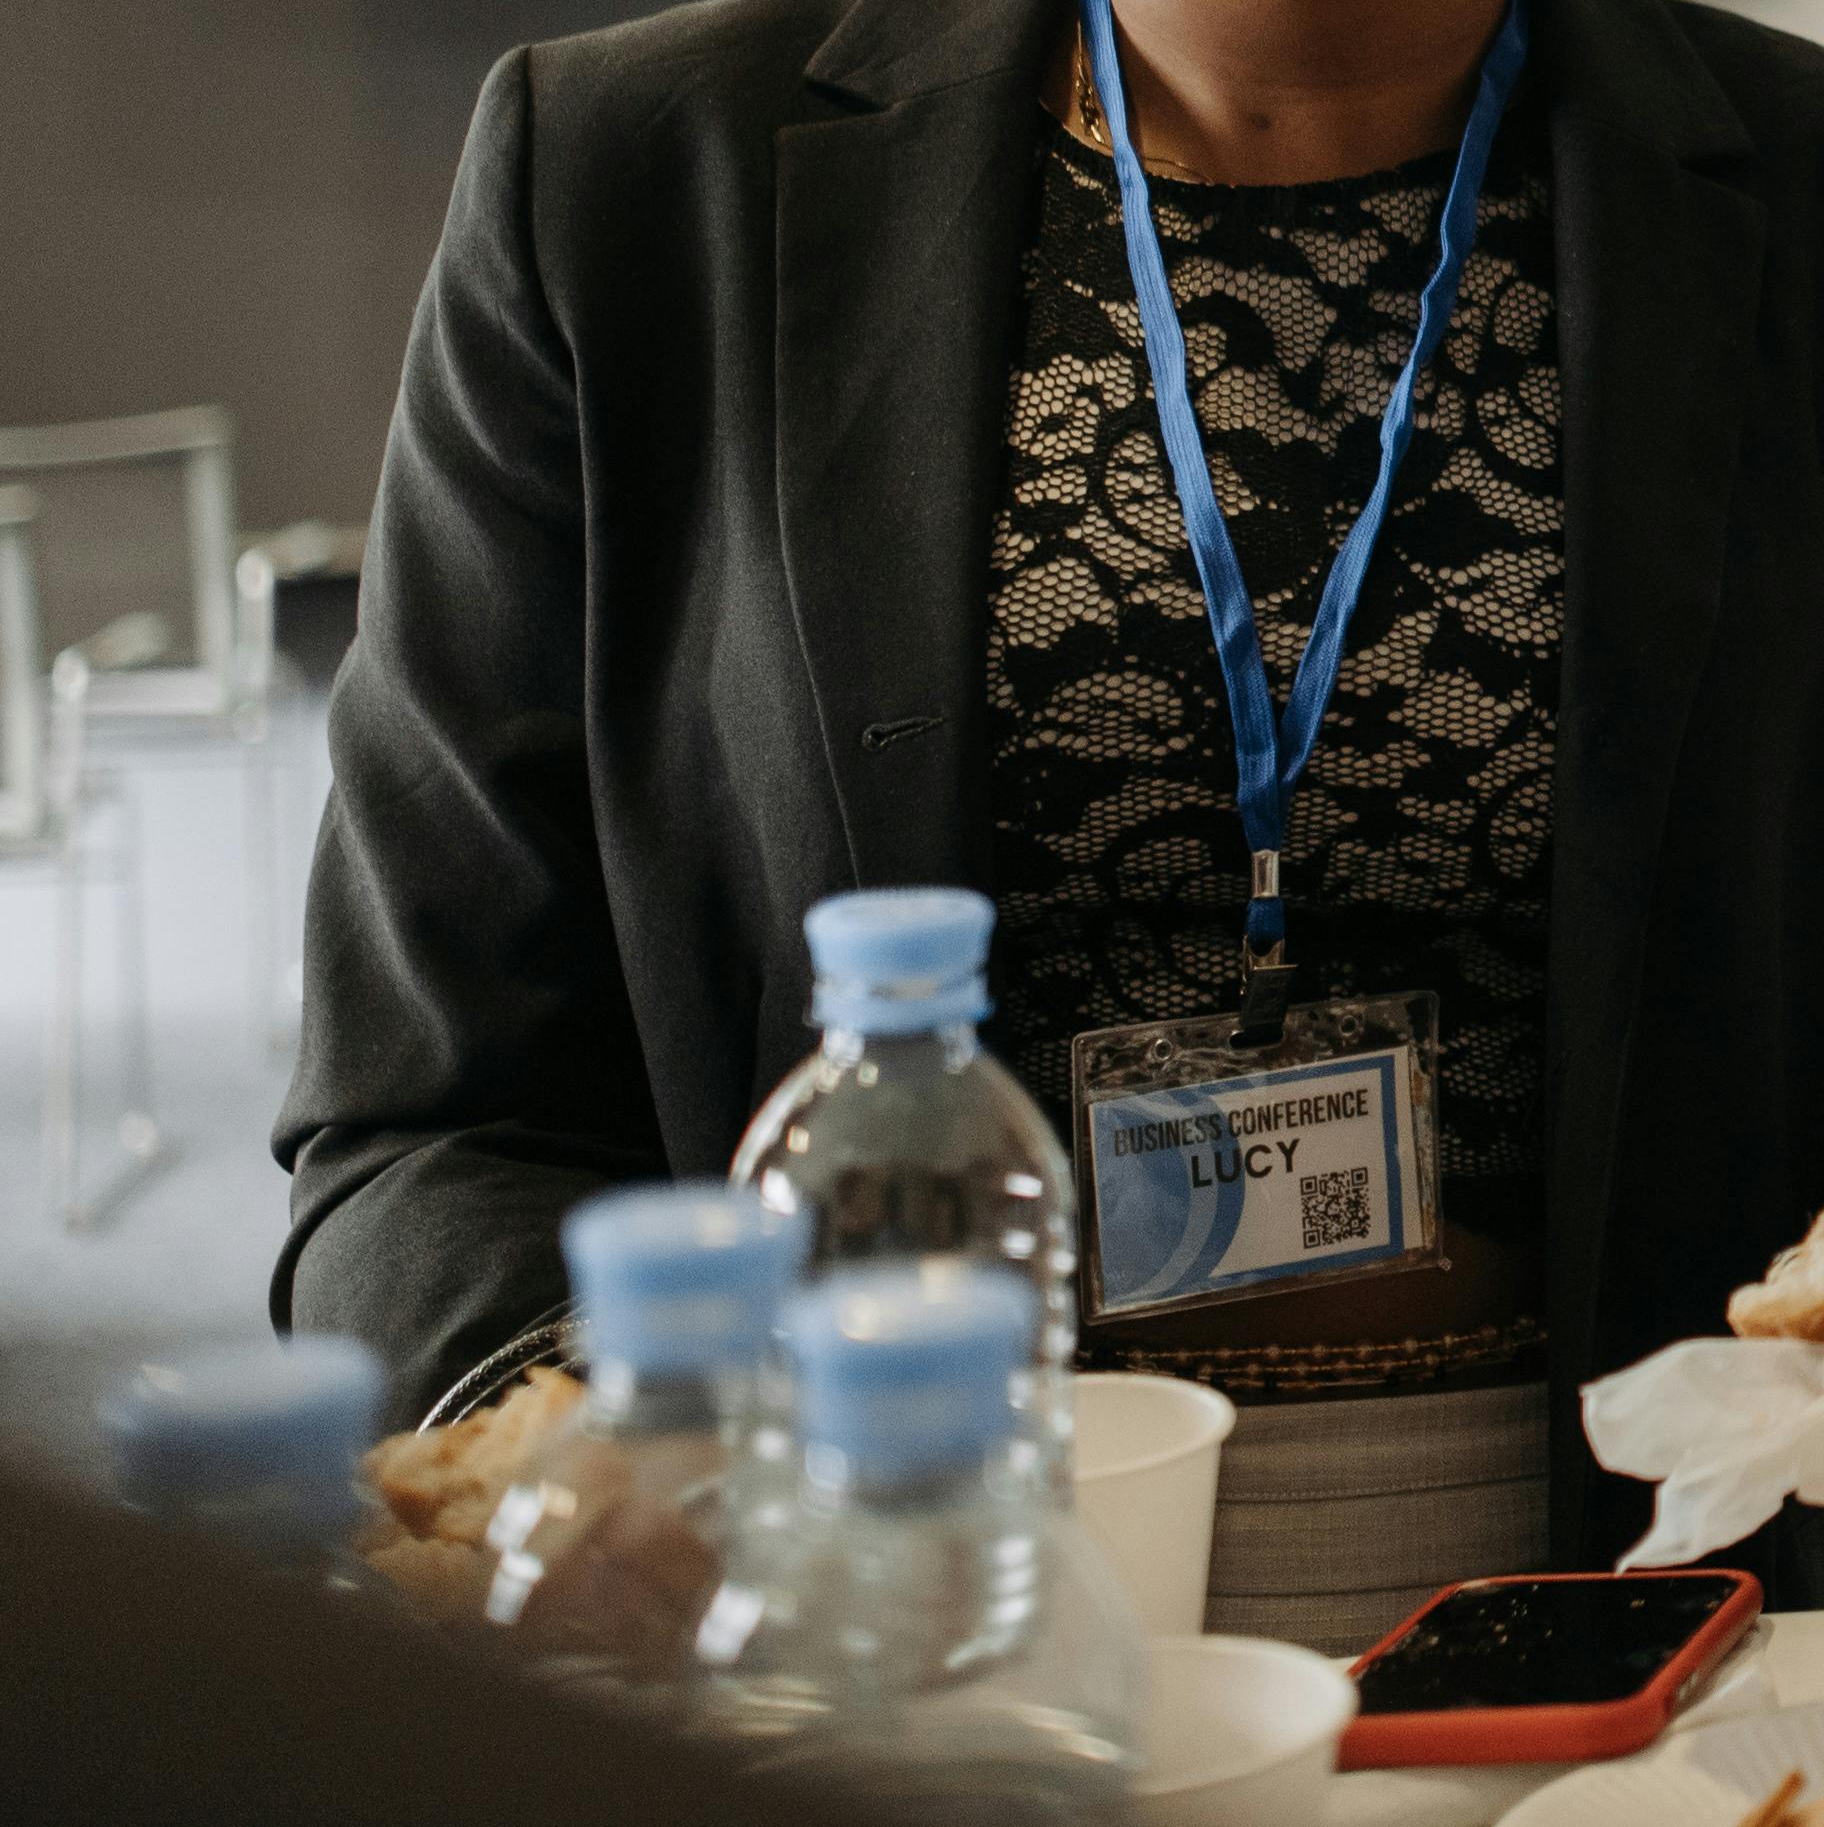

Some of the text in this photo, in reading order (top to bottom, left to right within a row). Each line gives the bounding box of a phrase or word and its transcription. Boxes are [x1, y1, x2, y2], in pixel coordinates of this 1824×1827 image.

[1114, 1088, 1369, 1158] BUSINESS CONFERENCE
[1190, 1138, 1300, 1189] LUCY
